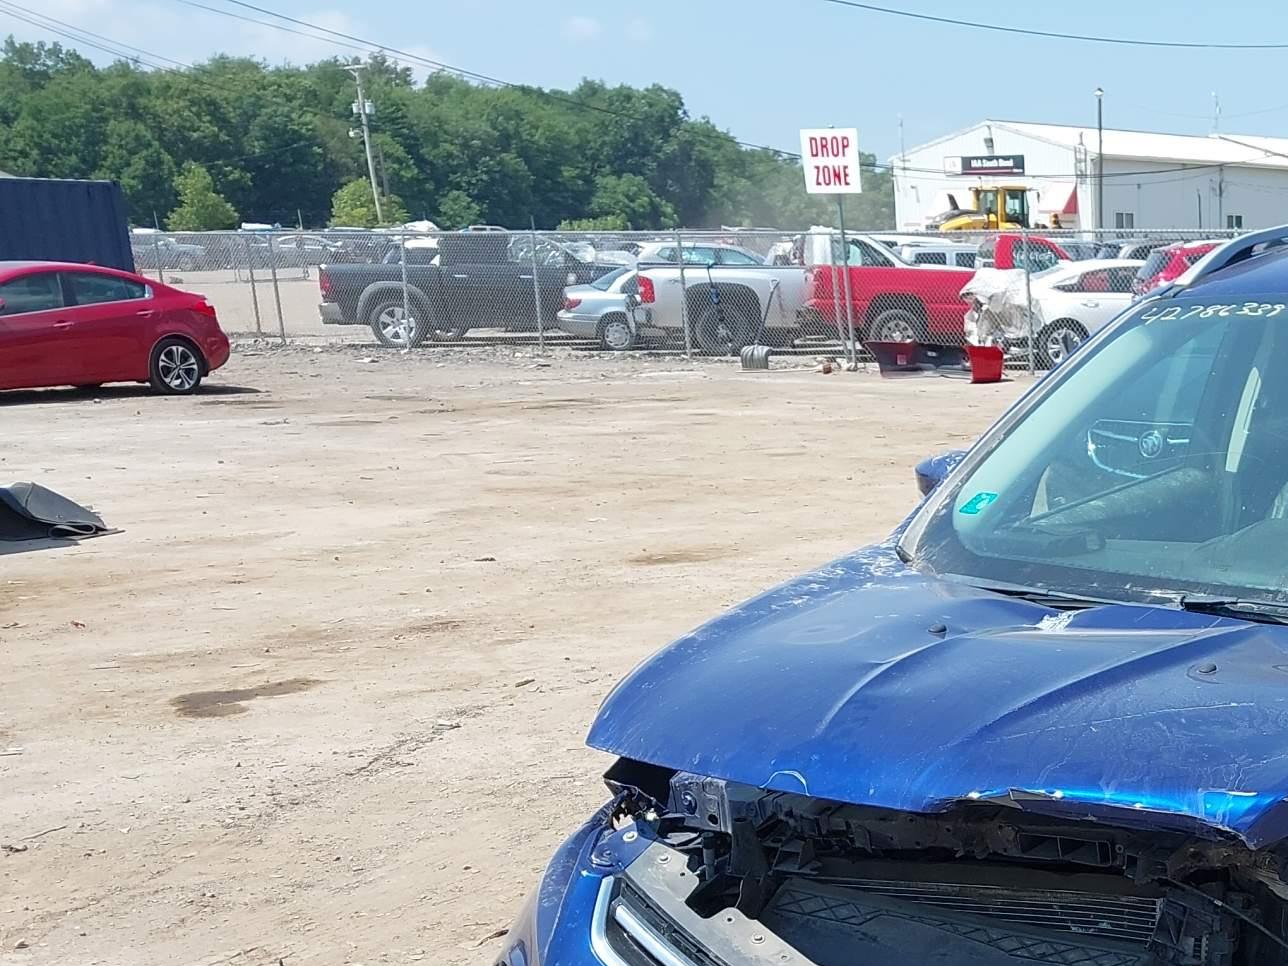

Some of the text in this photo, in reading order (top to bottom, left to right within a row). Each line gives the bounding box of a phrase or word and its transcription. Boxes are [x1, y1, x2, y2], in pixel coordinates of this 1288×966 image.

[808, 136, 849, 158] DROP
[814, 165, 850, 186] ZONE
[1141, 302, 1286, 325] 42786339
